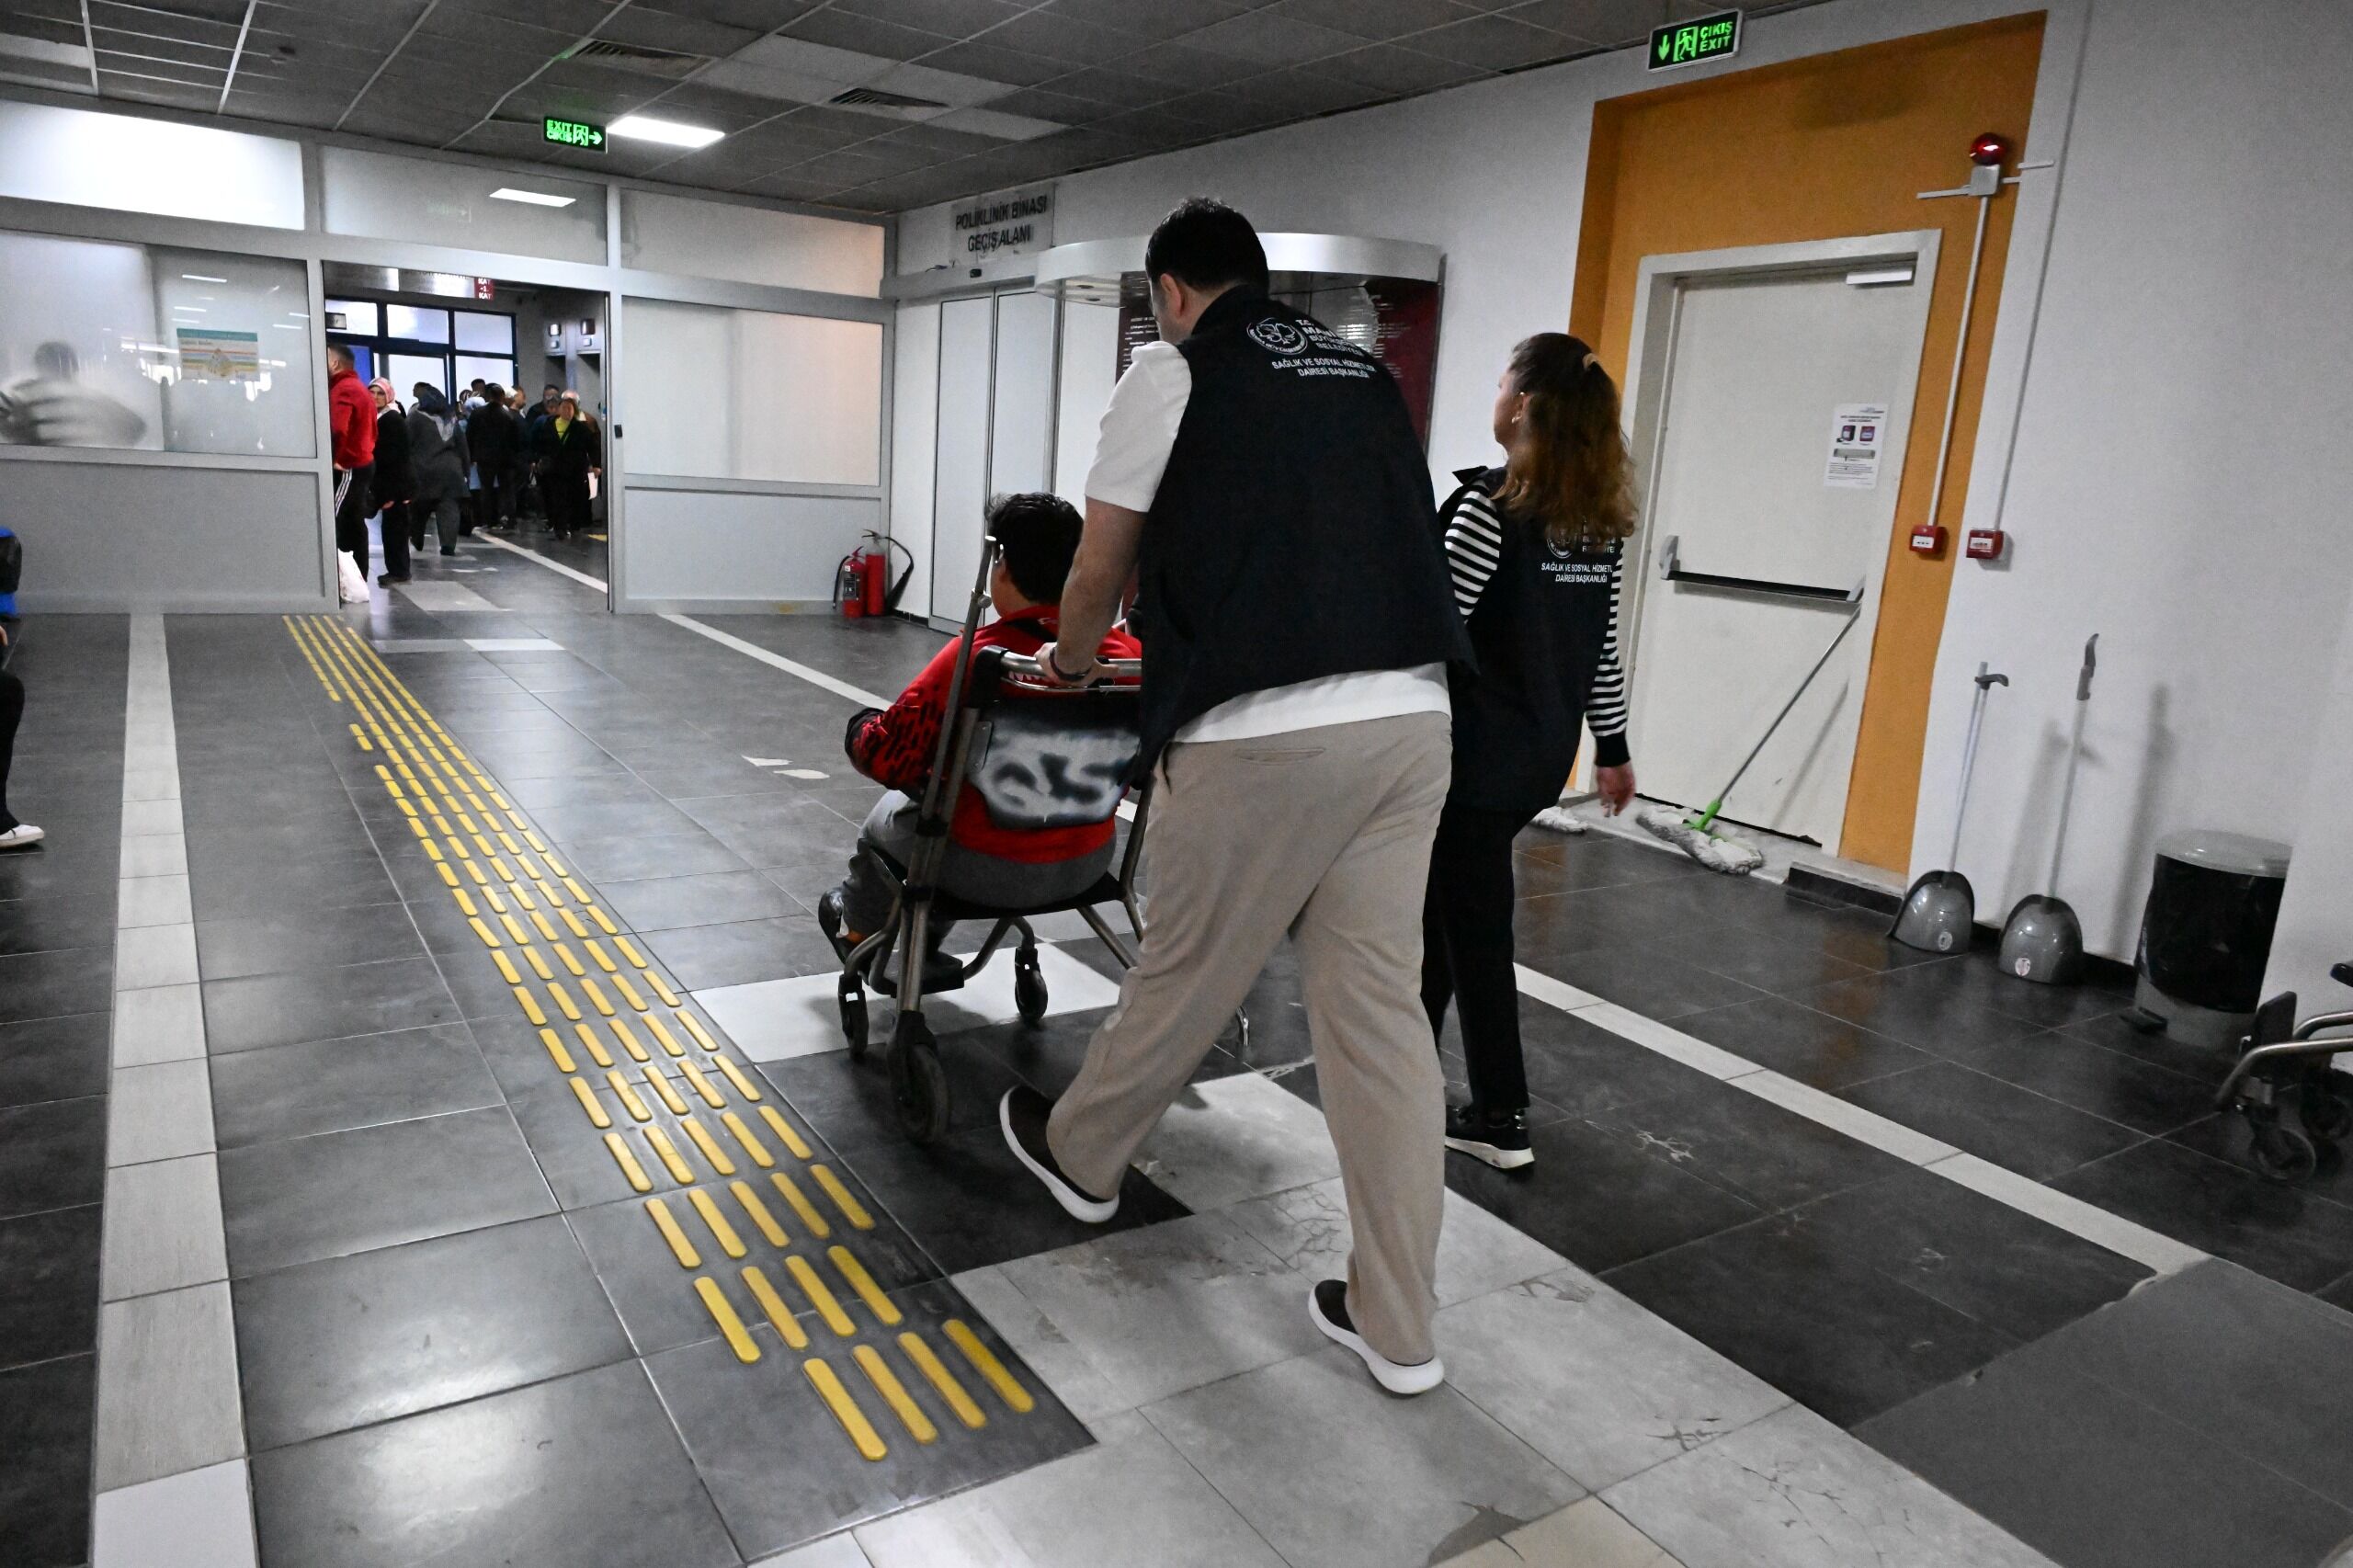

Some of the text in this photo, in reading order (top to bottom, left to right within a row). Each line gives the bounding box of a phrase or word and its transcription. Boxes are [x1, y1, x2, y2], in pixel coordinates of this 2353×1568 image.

[1699, 21, 1733, 40] ÇIKIŞ
[1699, 35, 1731, 51] EXIT
[547, 119, 572, 132] EXIT
[1012, 195, 1047, 219] BİNASI
[968, 224, 1030, 253] GEÇİŞ ALANI
[1271, 358, 1302, 369] SAĞLIK
[1314, 358, 1344, 367] SOSYAL
[1297, 367, 1330, 378] DAİRESİ
[1541, 562, 1564, 572] SAĞLIK
[1571, 564, 1591, 573] SOSYAL
[1555, 573, 1608, 585] DAİRESİ BAŞKANLIĞI
